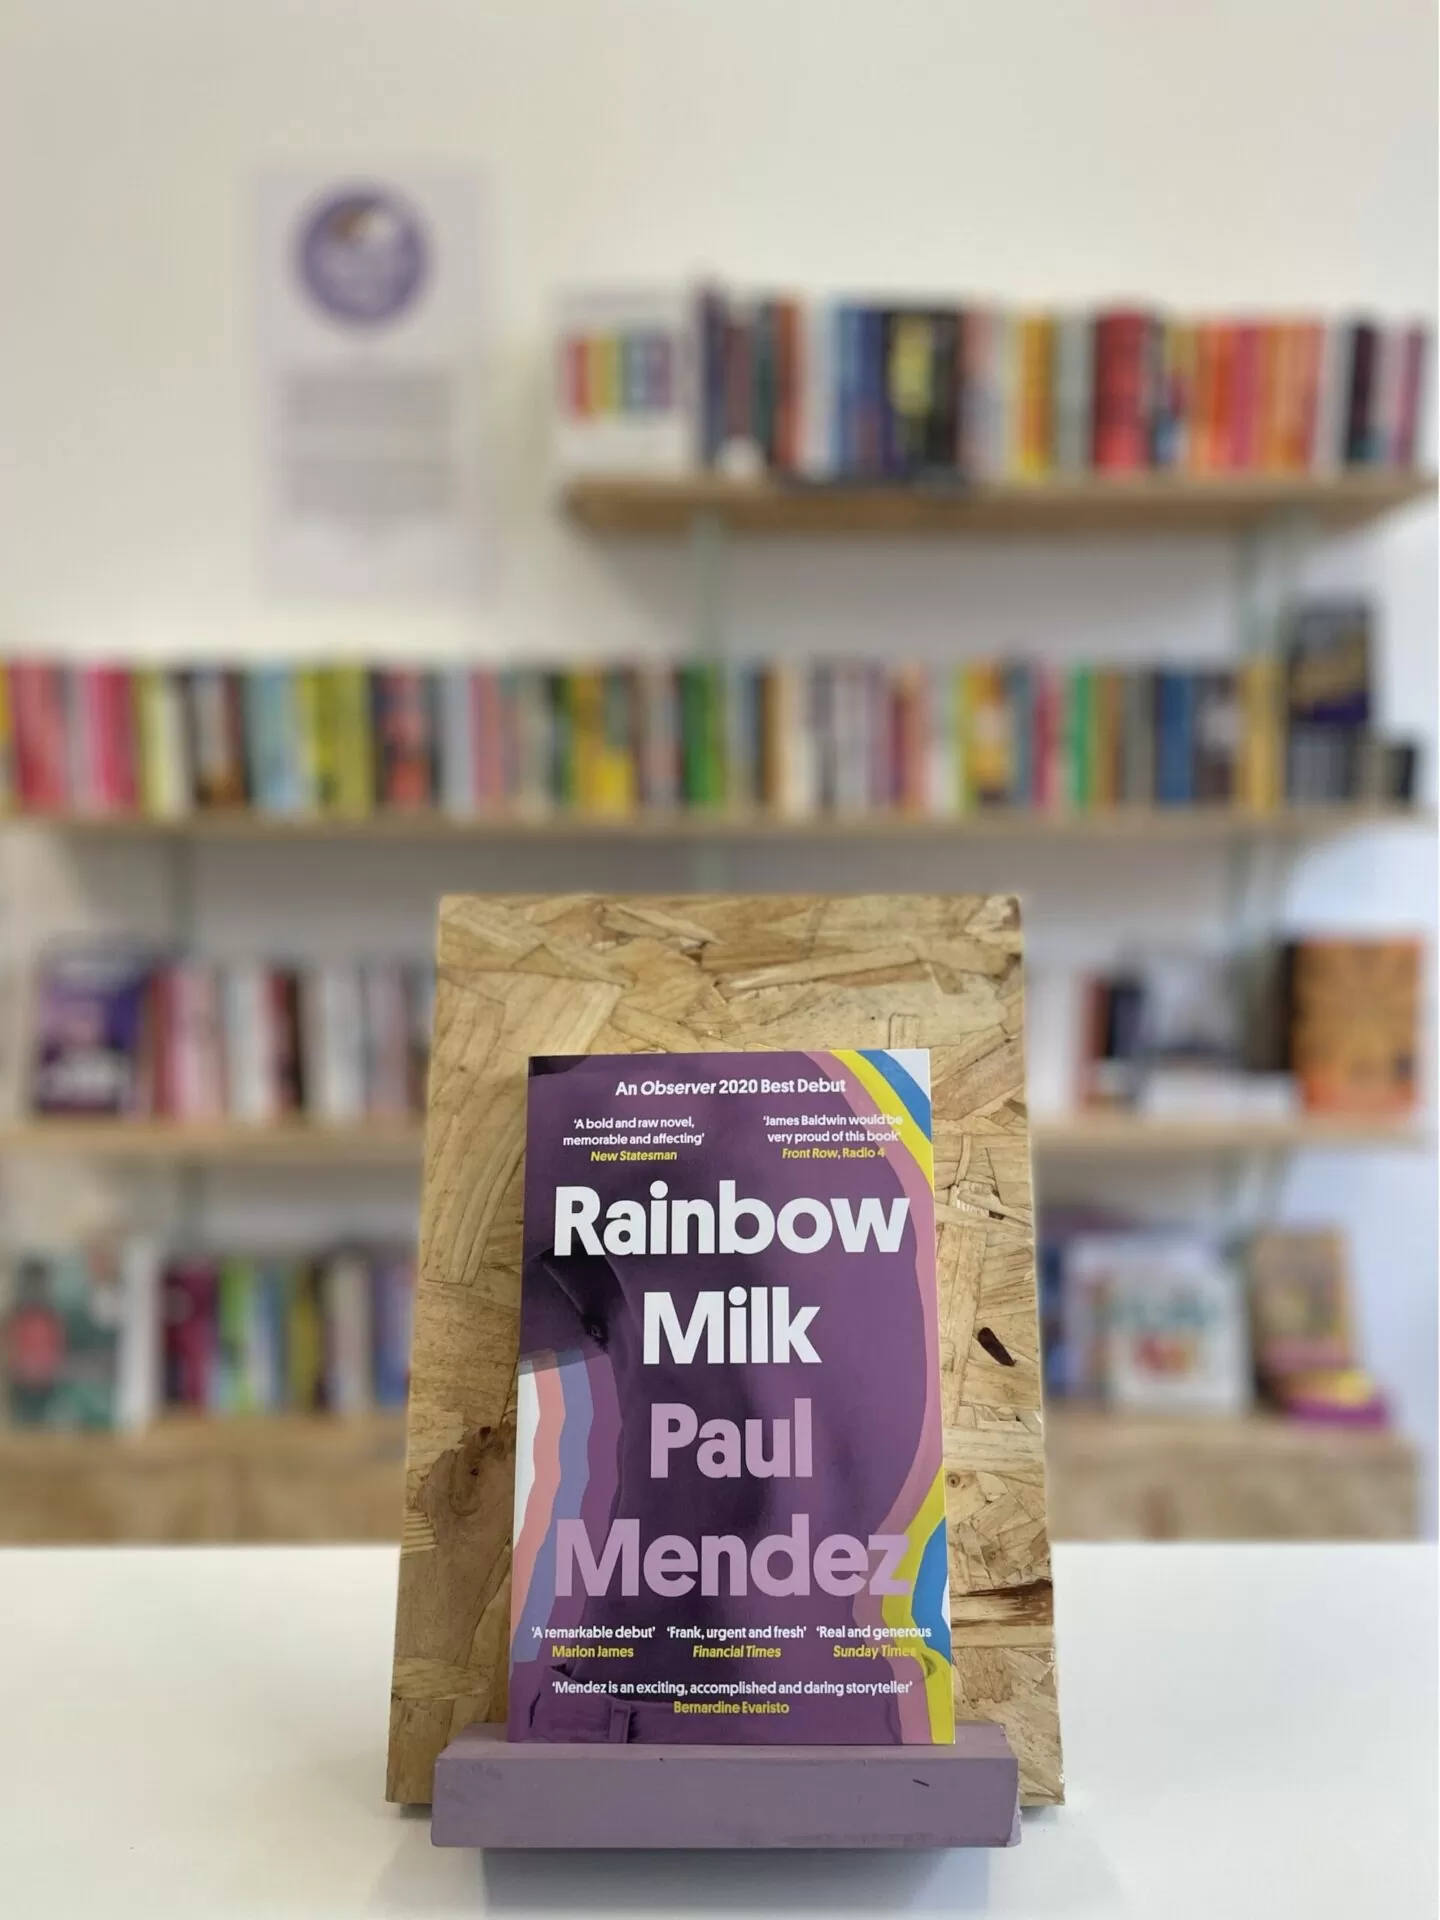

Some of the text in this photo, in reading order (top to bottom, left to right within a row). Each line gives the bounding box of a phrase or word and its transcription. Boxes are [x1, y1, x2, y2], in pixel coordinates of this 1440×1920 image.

[615, 1078, 846, 1096] An Observer 2020 Best Debut
[585, 1117, 614, 1129] bold
[615, 1117, 637, 1129] and
[637, 1119, 660, 1128] raw
[660, 1116, 695, 1128] novel,
[801, 1114, 847, 1126] Baldwin
[848, 1114, 886, 1126] would
[886, 1115, 904, 1126] be
[562, 1134, 628, 1146] memorable
[629, 1133, 652, 1145] and
[767, 1132, 793, 1144] very
[794, 1130, 831, 1144] proud
[831, 1130, 845, 1142] of
[845, 1130, 867, 1142] this
[590, 1151, 678, 1162] New Statesman
[782, 1147, 885, 1160] Front Row, Radio 4
[553, 1179, 911, 1257] Rainbow
[642, 1286, 823, 1365] Milk
[649, 1397, 813, 1479] Paul
[554, 1513, 911, 1598] Mendez
[544, 1625, 613, 1639] remarkable
[706, 1627, 747, 1641] urgent
[748, 1625, 772, 1639] and
[847, 1625, 871, 1638] and
[551, 1644, 635, 1658] Marlon James
[692, 1644, 782, 1658] Financial Times
[833, 1644, 880, 1660] Sunday
[608, 1680, 619, 1694] is
[619, 1683, 635, 1694] an
[636, 1680, 688, 1697] exciting,
[689, 1680, 776, 1697] accomplished
[778, 1680, 802, 1694] and
[803, 1680, 845, 1696] daring
[673, 1700, 790, 1714] Bernardine Evaristo
